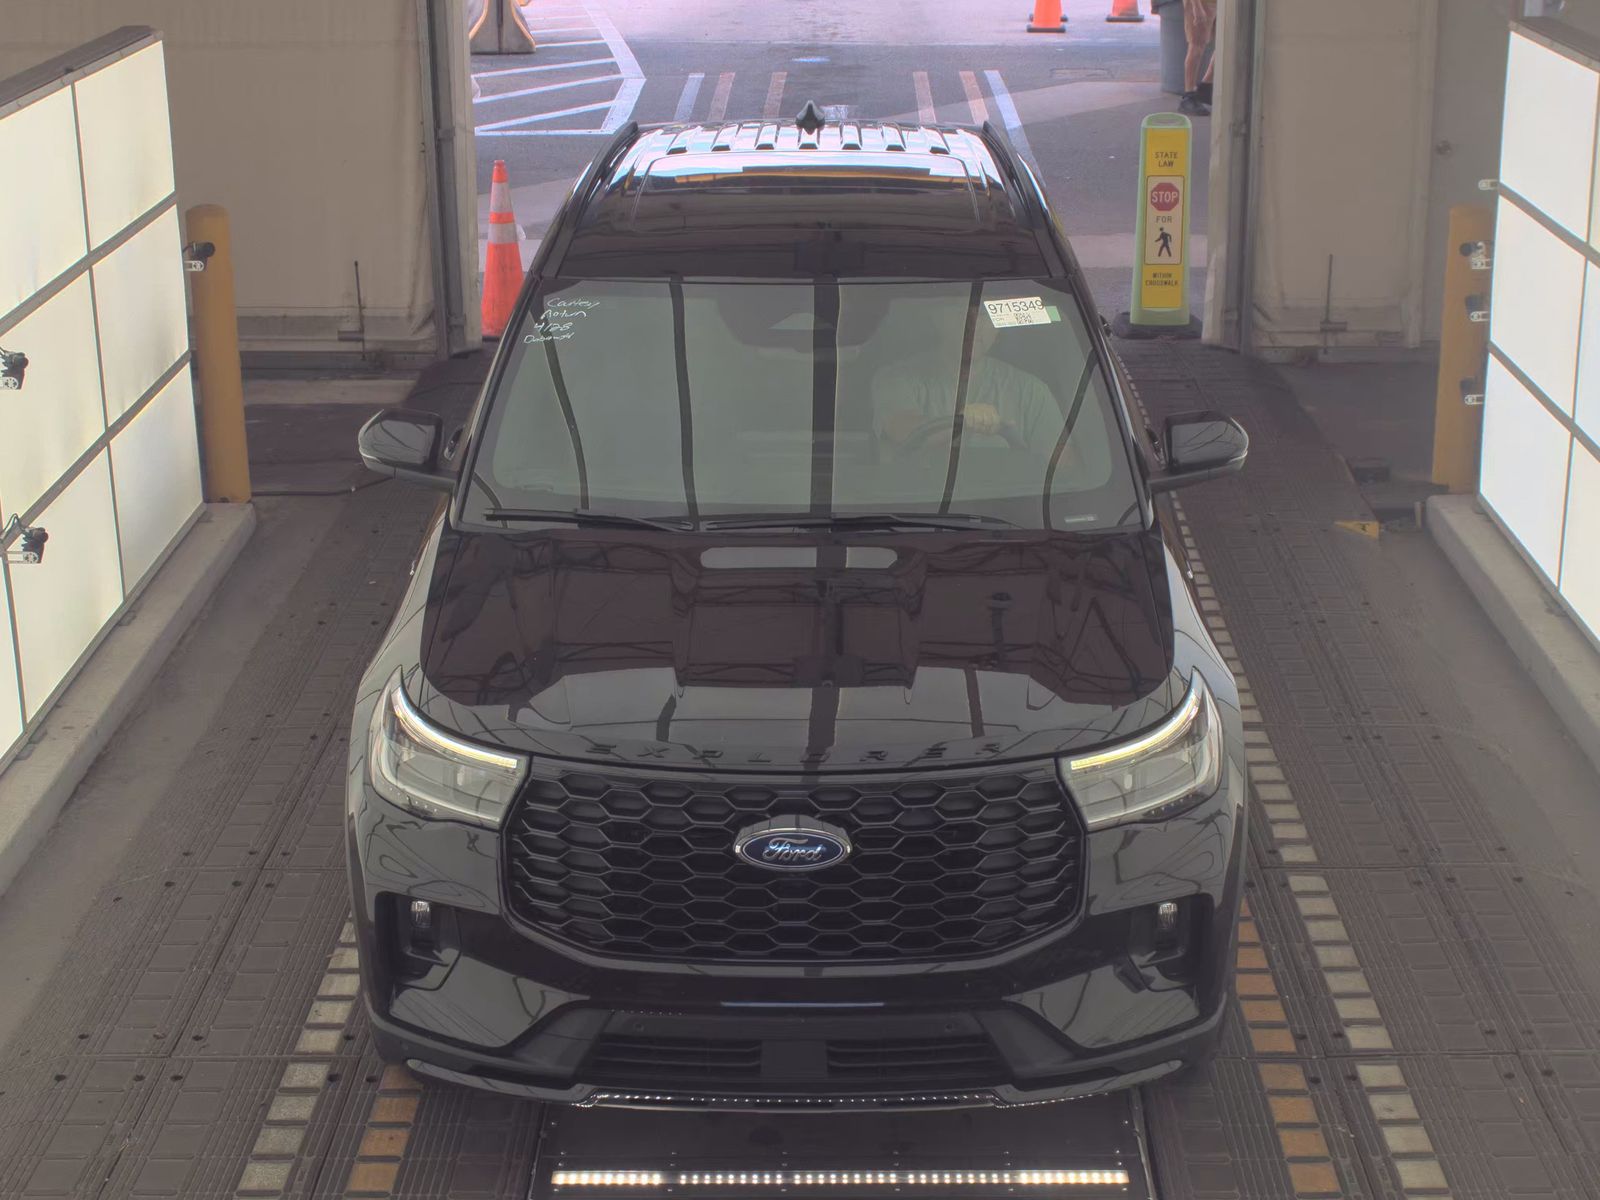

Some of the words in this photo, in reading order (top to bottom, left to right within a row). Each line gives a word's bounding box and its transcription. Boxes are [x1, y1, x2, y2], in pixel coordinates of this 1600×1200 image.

[1154, 151, 1178, 160] STATE
[1158, 160, 1174, 168] LAW
[1151, 191, 1178, 203] STOP
[1156, 215, 1172, 223] FOR
[988, 300, 1044, 314] 9715349
[585, 744, 1000, 764] EXPLORER
[762, 837, 826, 861] Ford
